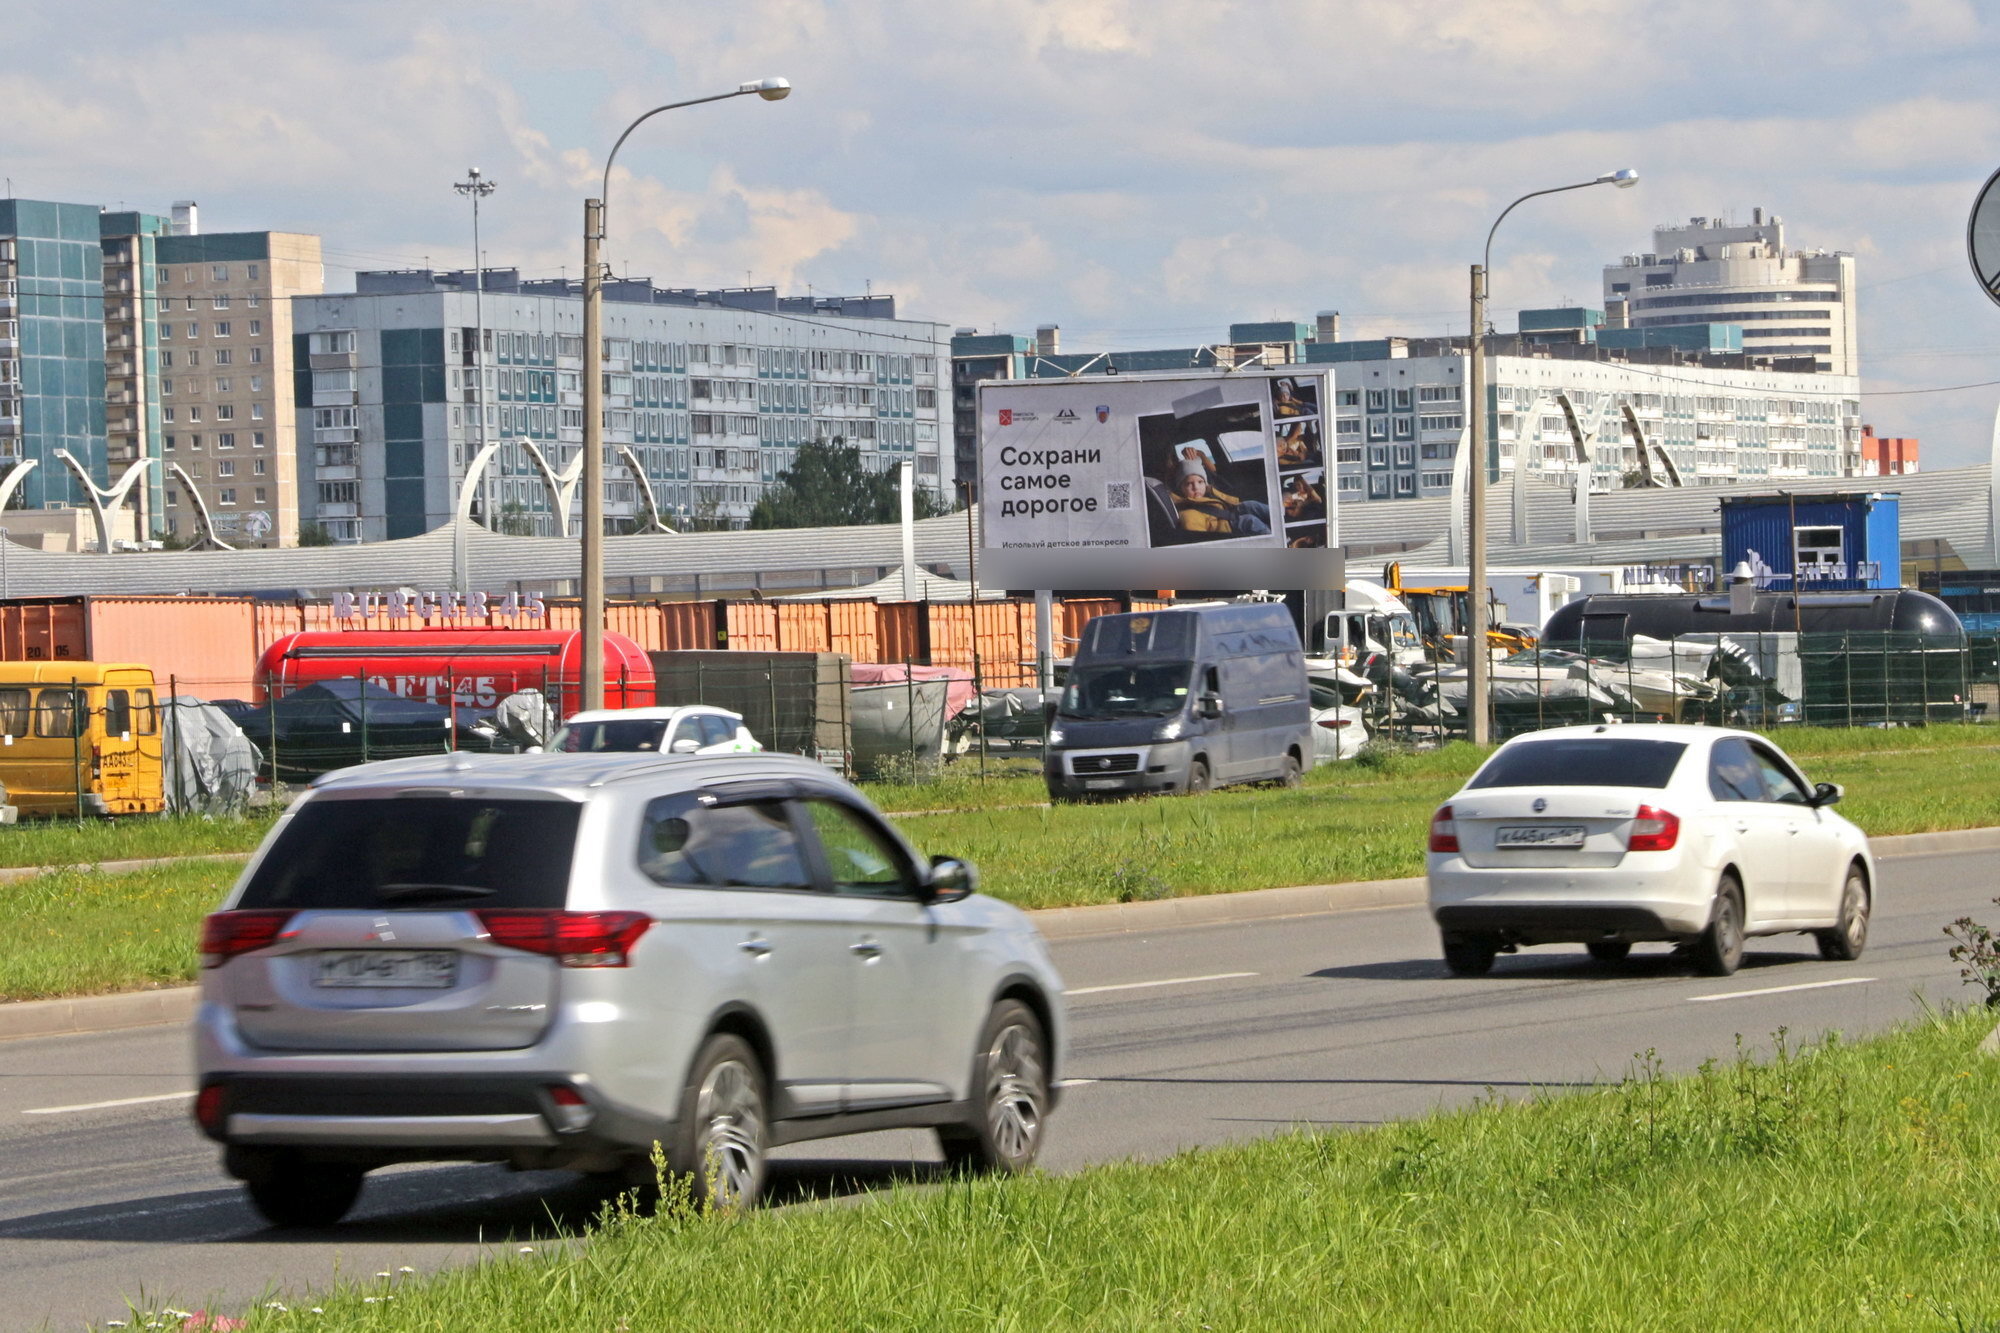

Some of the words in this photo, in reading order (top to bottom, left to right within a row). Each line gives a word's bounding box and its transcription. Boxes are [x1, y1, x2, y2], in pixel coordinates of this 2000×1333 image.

[1000, 446, 1101, 469] Сохрани
[1000, 474, 1071, 490] самое
[1001, 497, 1098, 518] дорогое
[1002, 540, 1045, 549] Используй
[1082, 539, 1129, 547] автокресло
[332, 592, 489, 618] BURGER
[500, 591, 545, 619] 45
[454, 676, 496, 707] 45
